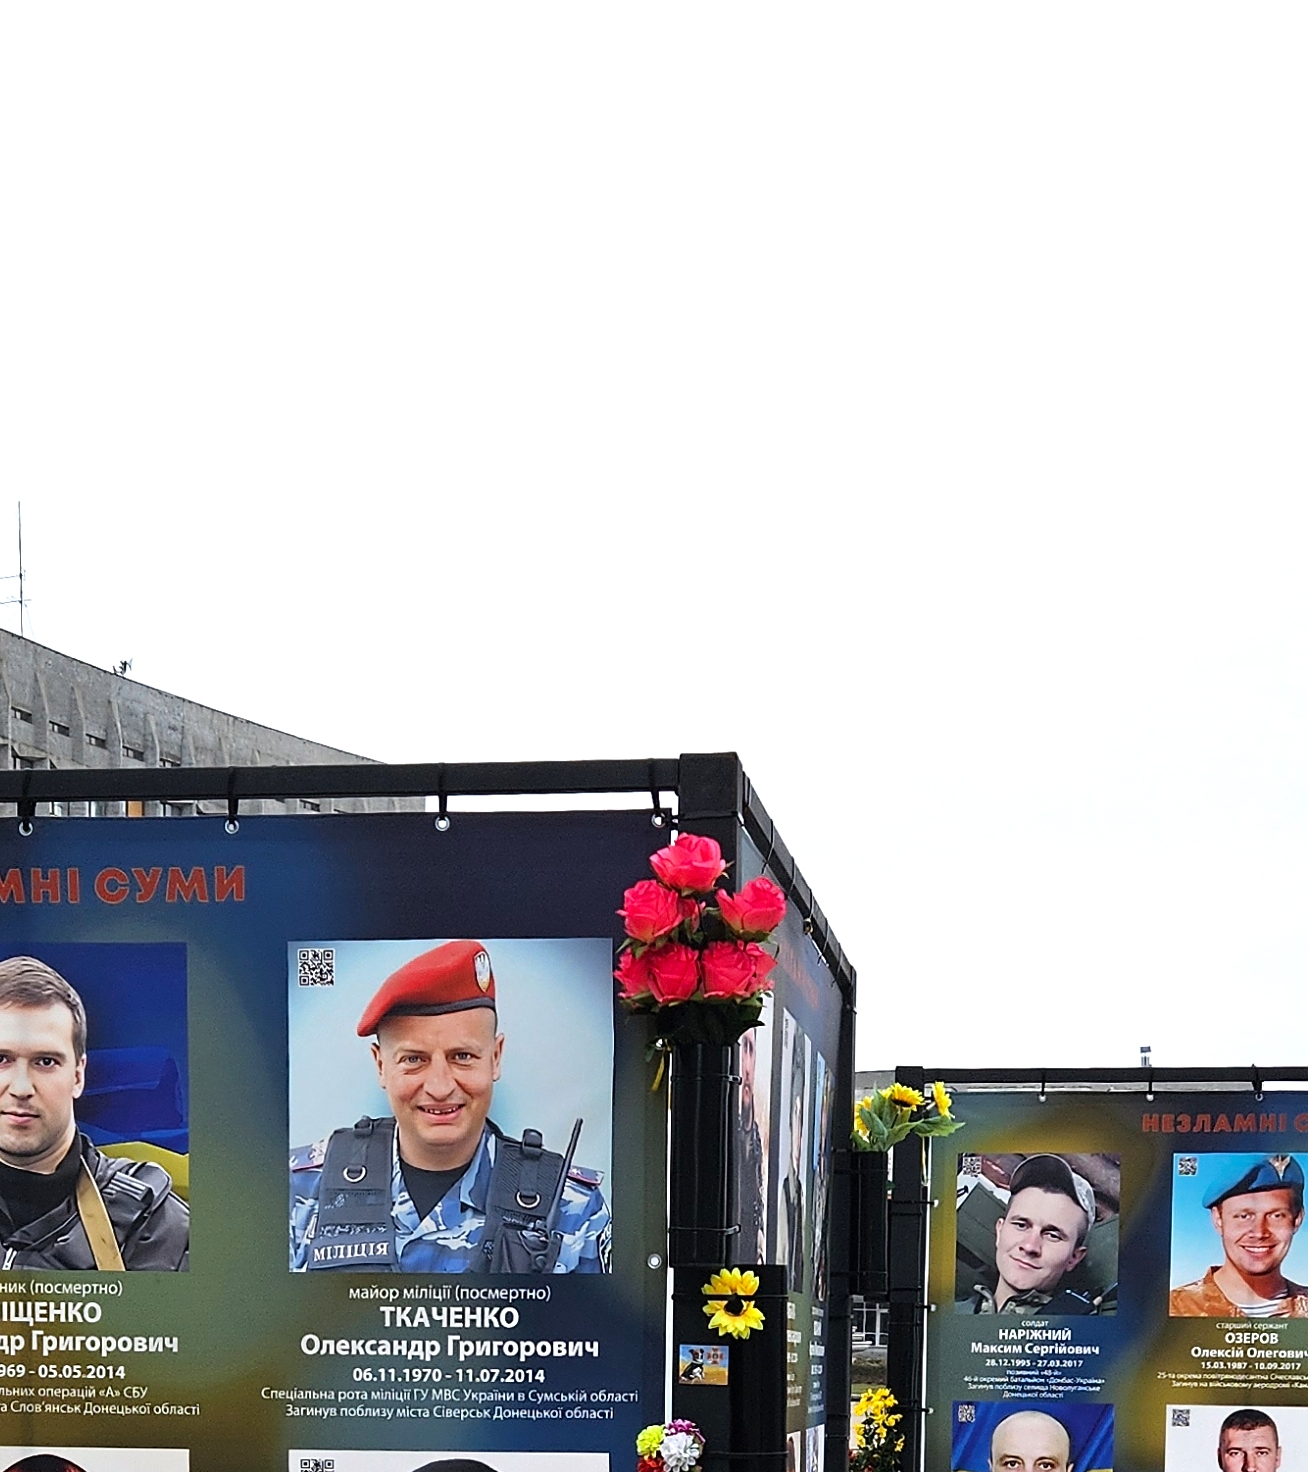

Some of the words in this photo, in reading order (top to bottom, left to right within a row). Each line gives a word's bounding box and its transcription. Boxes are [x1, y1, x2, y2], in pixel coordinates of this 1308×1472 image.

[94, 865, 245, 902] СУМИ
[1142, 1113, 1287, 1133] НЕЗЛАМНІ
[313, 1242, 389, 1261] МІЛІЦІЯ
[29, 1280, 123, 1297] (посмертно)
[348, 1285, 400, 1302] майор
[402, 1284, 452, 1301] міліції
[455, 1285, 551, 1302] (посмертно)
[379, 1306, 519, 1328] ТКАЧЕНКО
[998, 1328, 1072, 1340] НАРІЖНИЙ
[1224, 1332, 1279, 1344] ОЗЕРОВ
[31, 1330, 178, 1356] Григорович
[300, 1334, 441, 1360] Олександр
[447, 1335, 599, 1361] Григорович
[970, 1342, 1023, 1353] Максим
[1024, 1342, 1100, 1356] Сергійович
[1190, 1346, 1244, 1358] Олексій
[37, 1364, 126, 1379] 05.05.2014
[352, 1367, 442, 1382] 06.11.1970
[455, 1368, 545, 1383] 11.07.2014
[37, 1385, 96, 1399] операцій
[98, 1385, 121, 1397] «А»
[123, 1386, 148, 1399] СБУ
[82, 1401, 152, 1416] Донецької
[152, 1402, 200, 1415] області
[285, 1404, 337, 1419] Загинув
[339, 1404, 395, 1419] поблизу
[395, 1405, 430, 1418] міста
[432, 1405, 491, 1420] Сіверськ
[492, 1405, 563, 1420] Донецької
[564, 1406, 614, 1419] області
